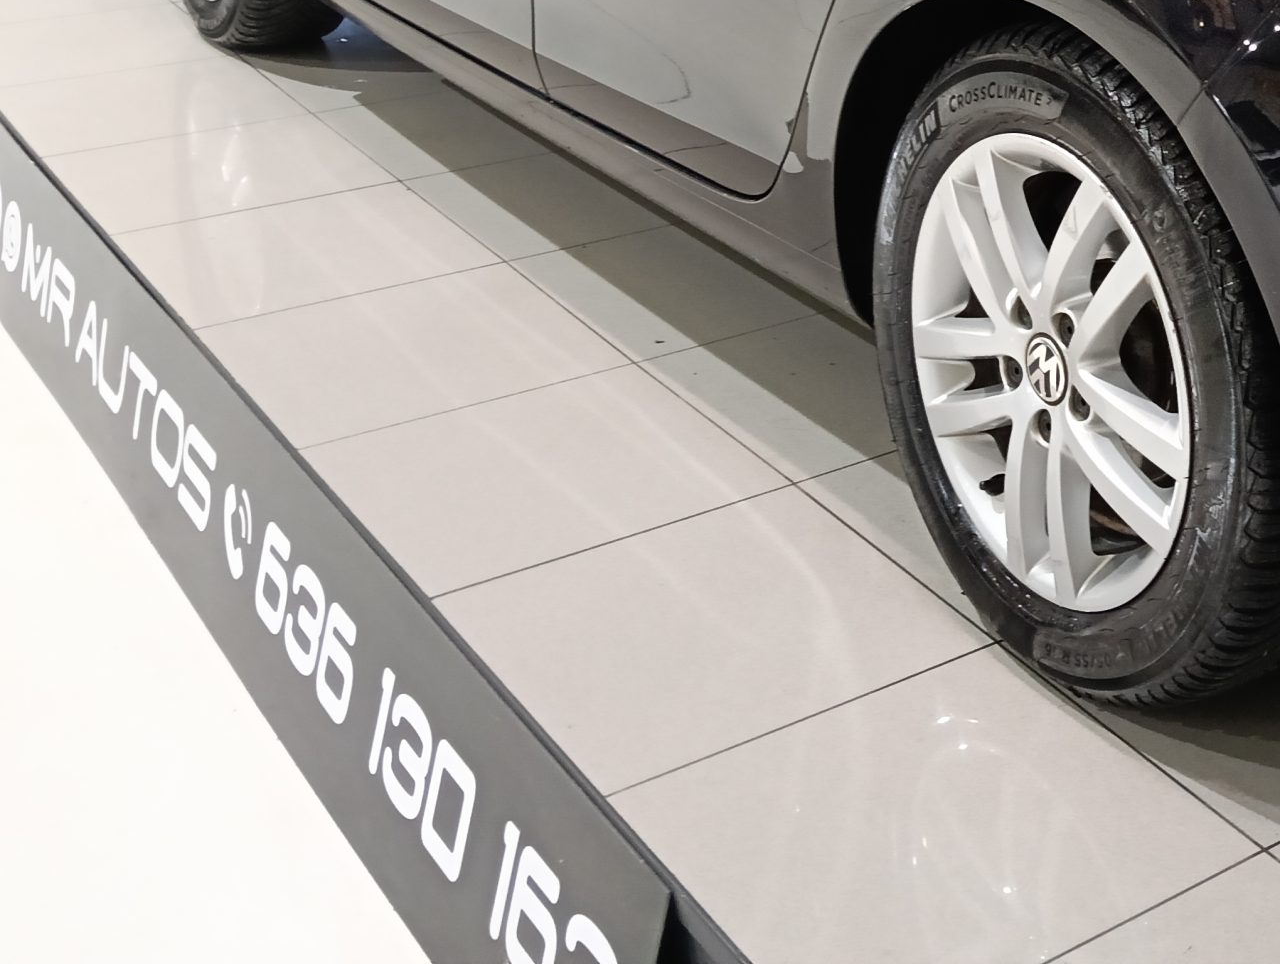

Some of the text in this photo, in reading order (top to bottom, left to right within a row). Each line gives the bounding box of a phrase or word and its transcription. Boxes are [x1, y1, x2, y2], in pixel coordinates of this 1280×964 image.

[21, 222, 75, 347] MR
[75, 300, 217, 532] AUTOS
[255, 521, 356, 725] 636
[368, 667, 476, 883] 130
